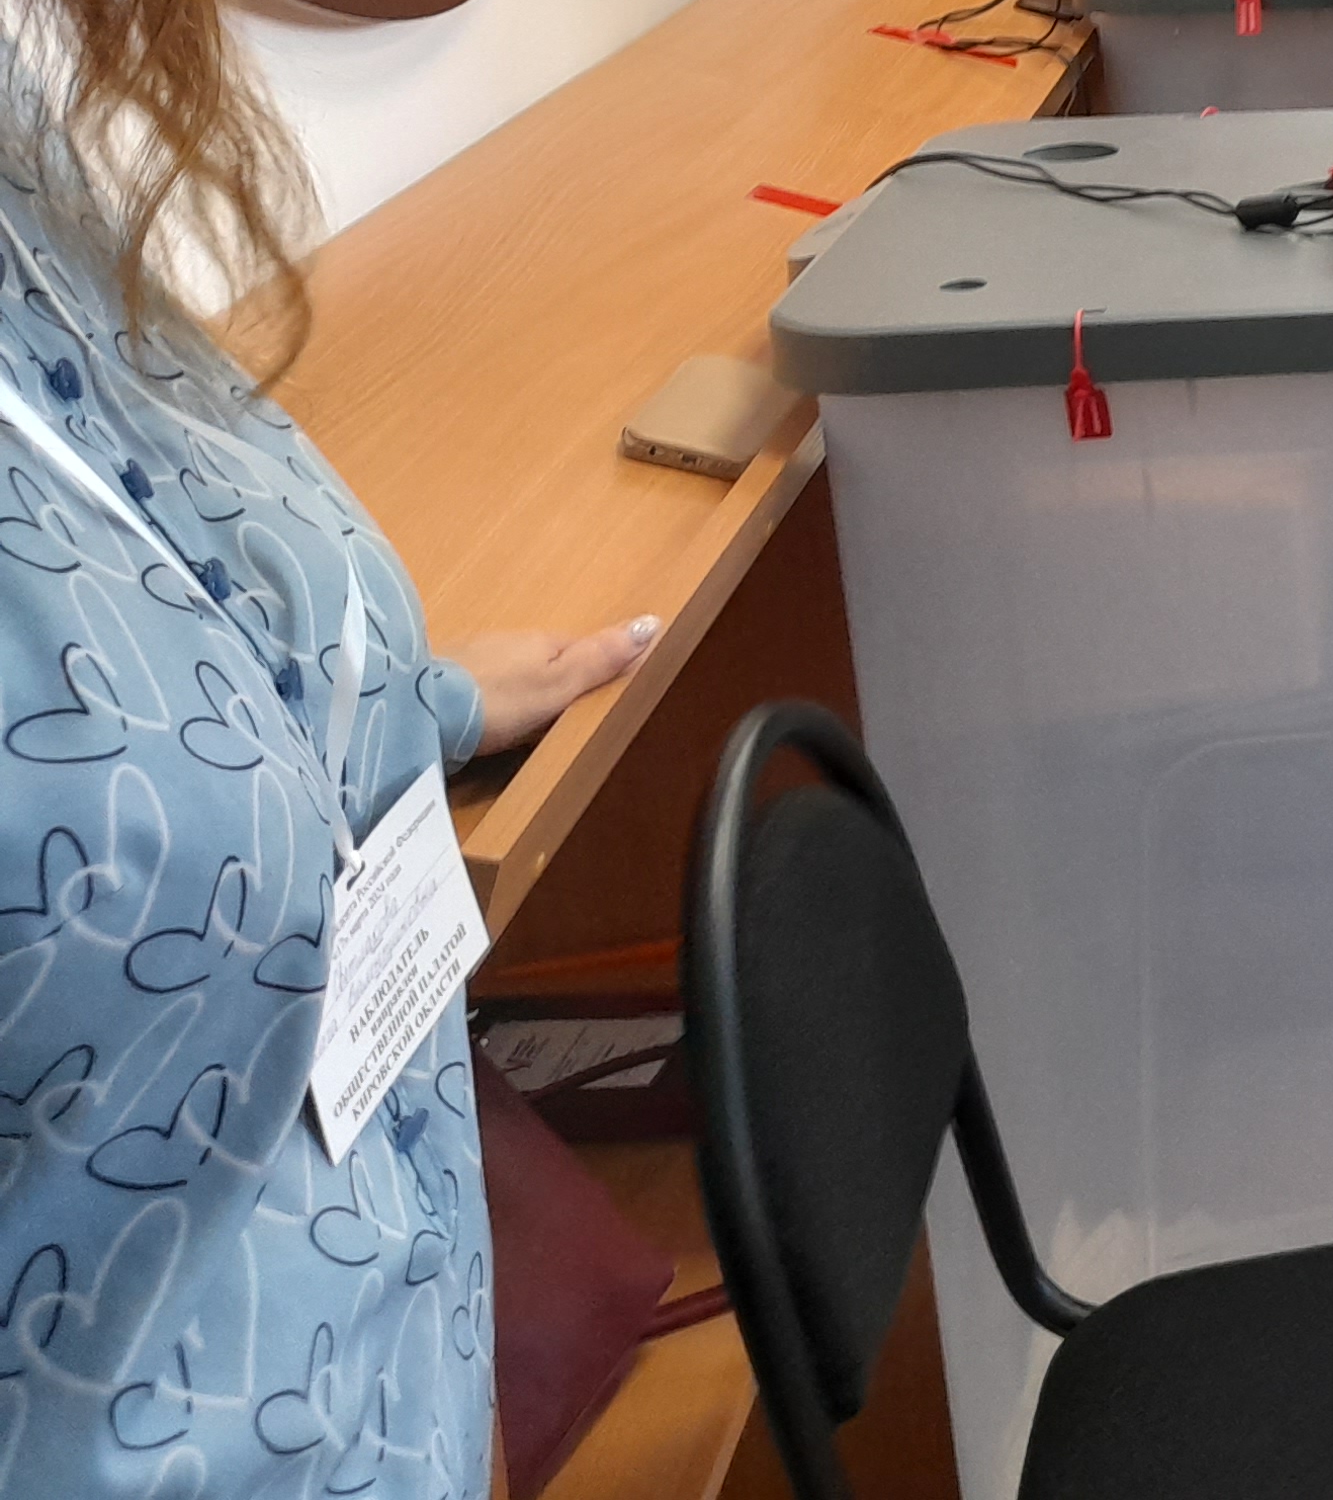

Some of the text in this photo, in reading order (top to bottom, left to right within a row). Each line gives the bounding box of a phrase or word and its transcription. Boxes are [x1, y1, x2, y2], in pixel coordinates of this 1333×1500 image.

[333, 989, 420, 1118] ОБЩЕСТВЕННОЙ
[418, 923, 467, 995] ПАЛАТОЙ
[349, 928, 430, 1044] НАБЛЮДАТЕЛЬ
[351, 1023, 415, 1122] КИРОВСКОЙ
[414, 958, 462, 1028] ОБЛАСТИ
